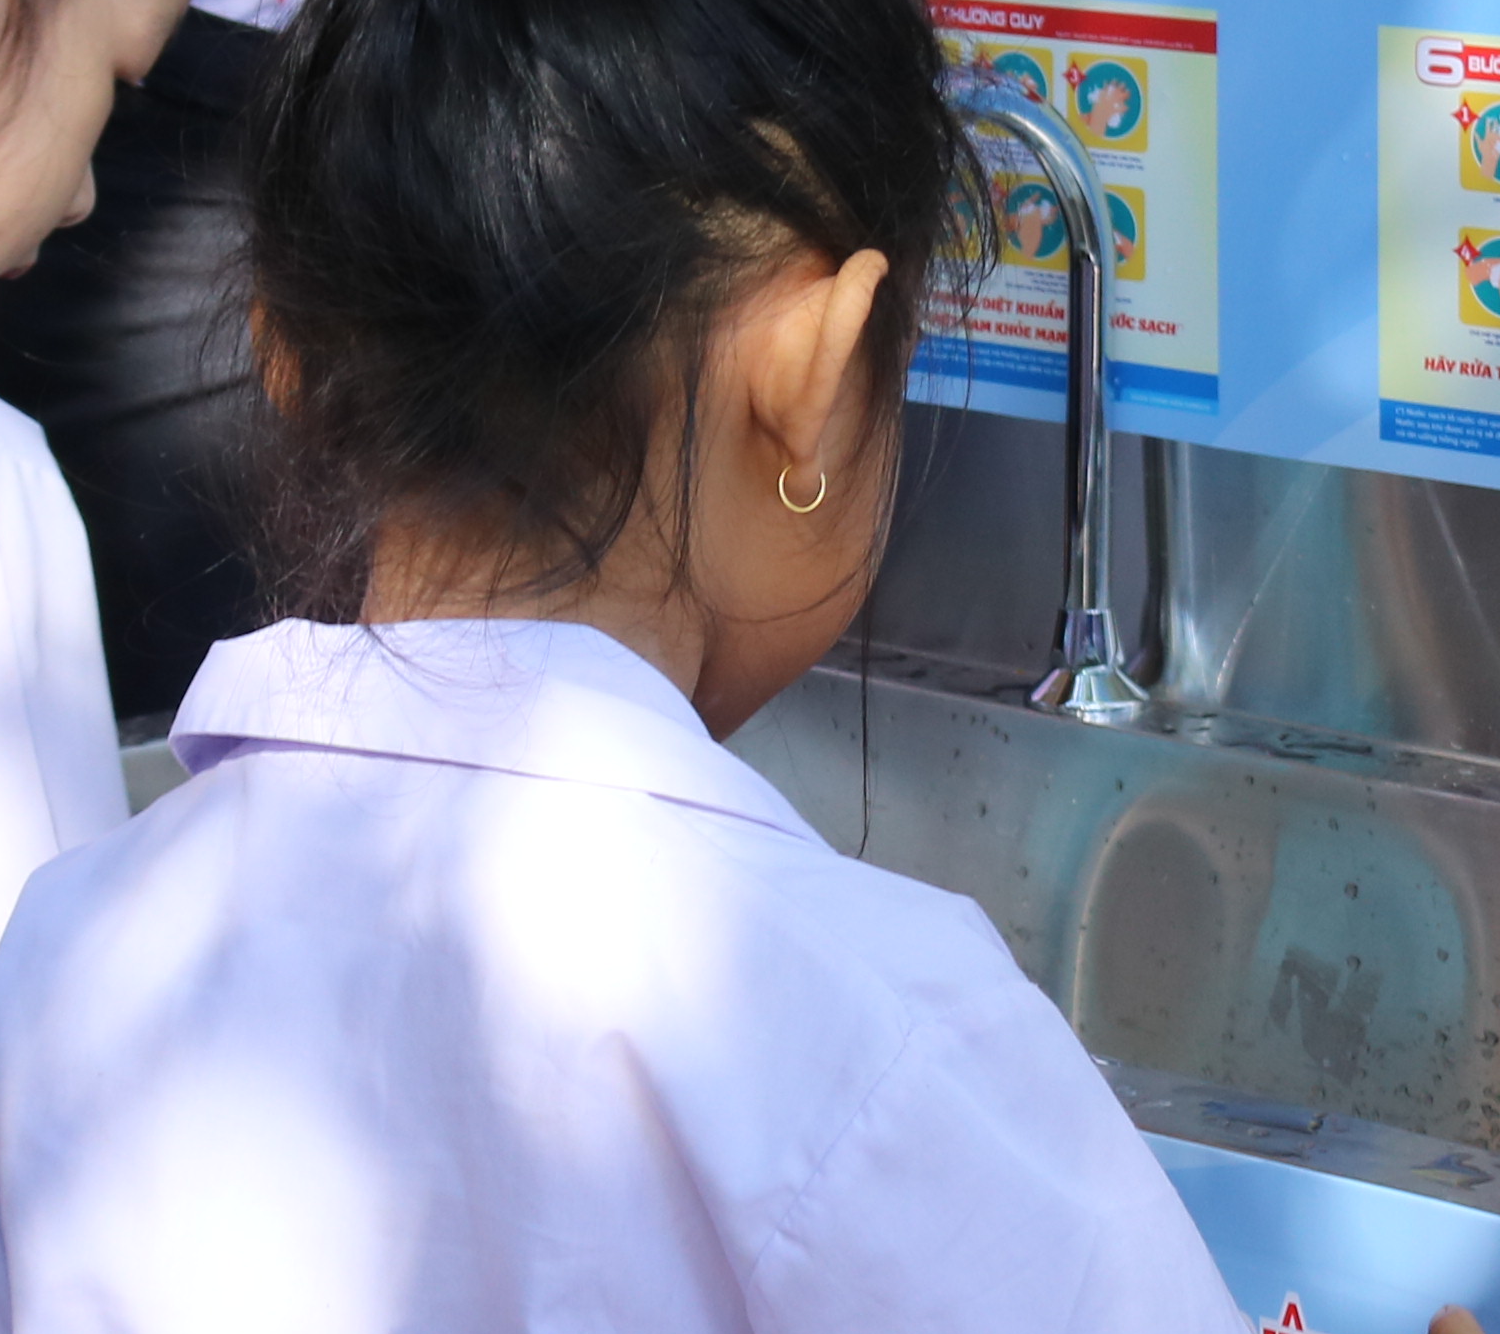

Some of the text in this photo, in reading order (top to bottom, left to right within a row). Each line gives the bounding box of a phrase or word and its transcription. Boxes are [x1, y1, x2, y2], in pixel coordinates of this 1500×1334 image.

[1008, 12, 1044, 30] QUY
[1417, 38, 1464, 85] 6
[1071, 68, 1080, 84] 3
[1461, 107, 1468, 122] 1
[1461, 246, 1471, 261] 4
[1016, 302, 1066, 320] KHUẨN
[1118, 315, 1133, 329] ỚC
[1139, 319, 1177, 333] SẠCH
[1035, 327, 1070, 343] MẠN
[1423, 356, 1457, 373] HÃY
[1459, 361, 1493, 378] RỬA
